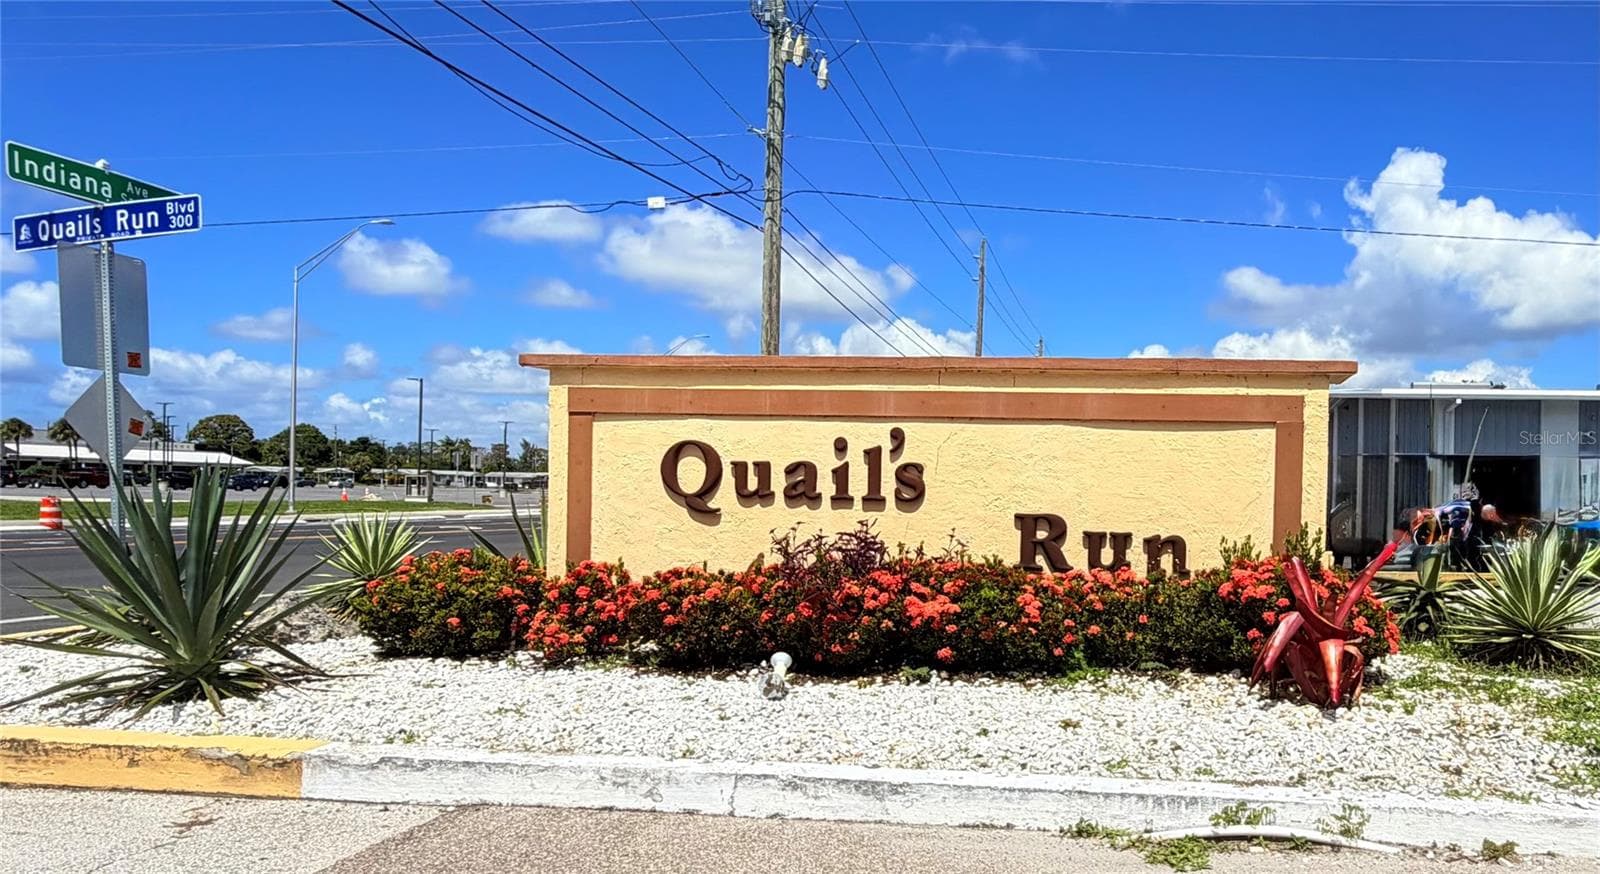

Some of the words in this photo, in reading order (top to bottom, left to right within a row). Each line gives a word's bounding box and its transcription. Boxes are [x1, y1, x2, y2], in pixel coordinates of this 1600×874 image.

[14, 151, 113, 199] Indiana
[126, 181, 149, 199] Ave
[38, 214, 102, 242] Quails
[116, 209, 159, 231] Run
[166, 200, 195, 215] Blvd
[168, 214, 193, 229] 300
[660, 427, 926, 518] Quail's
[1013, 513, 1191, 576] Run
